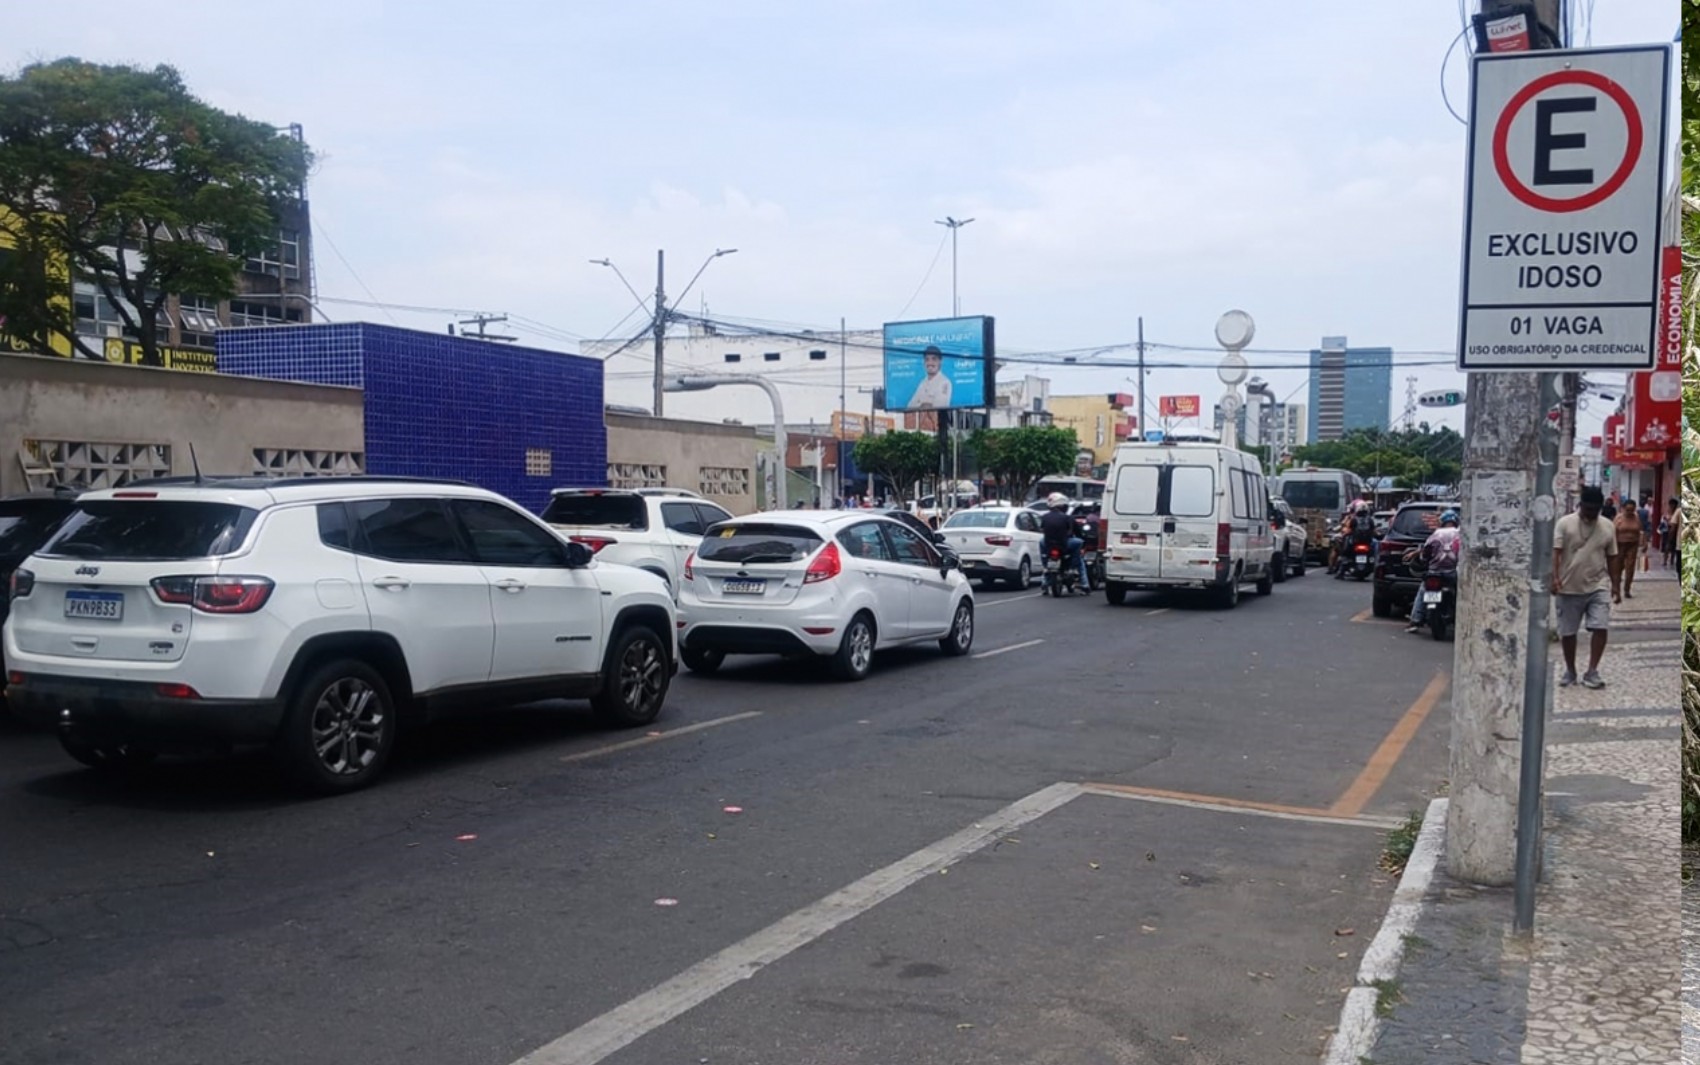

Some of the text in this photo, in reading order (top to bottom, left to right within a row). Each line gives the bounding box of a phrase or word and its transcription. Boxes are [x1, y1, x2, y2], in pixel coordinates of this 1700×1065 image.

[1533, 96, 1597, 186] E
[1488, 231, 1638, 257] EXCLUSIVO
[1518, 265, 1602, 288] IDOSO
[1510, 316, 1603, 335] 01 VAGA
[1667, 274, 1681, 364] ECONOMIA
[1469, 343, 1646, 355] USO OBRIGATÓRIO DA CREDENCIAL
[70, 600, 117, 616] PKN9B33
